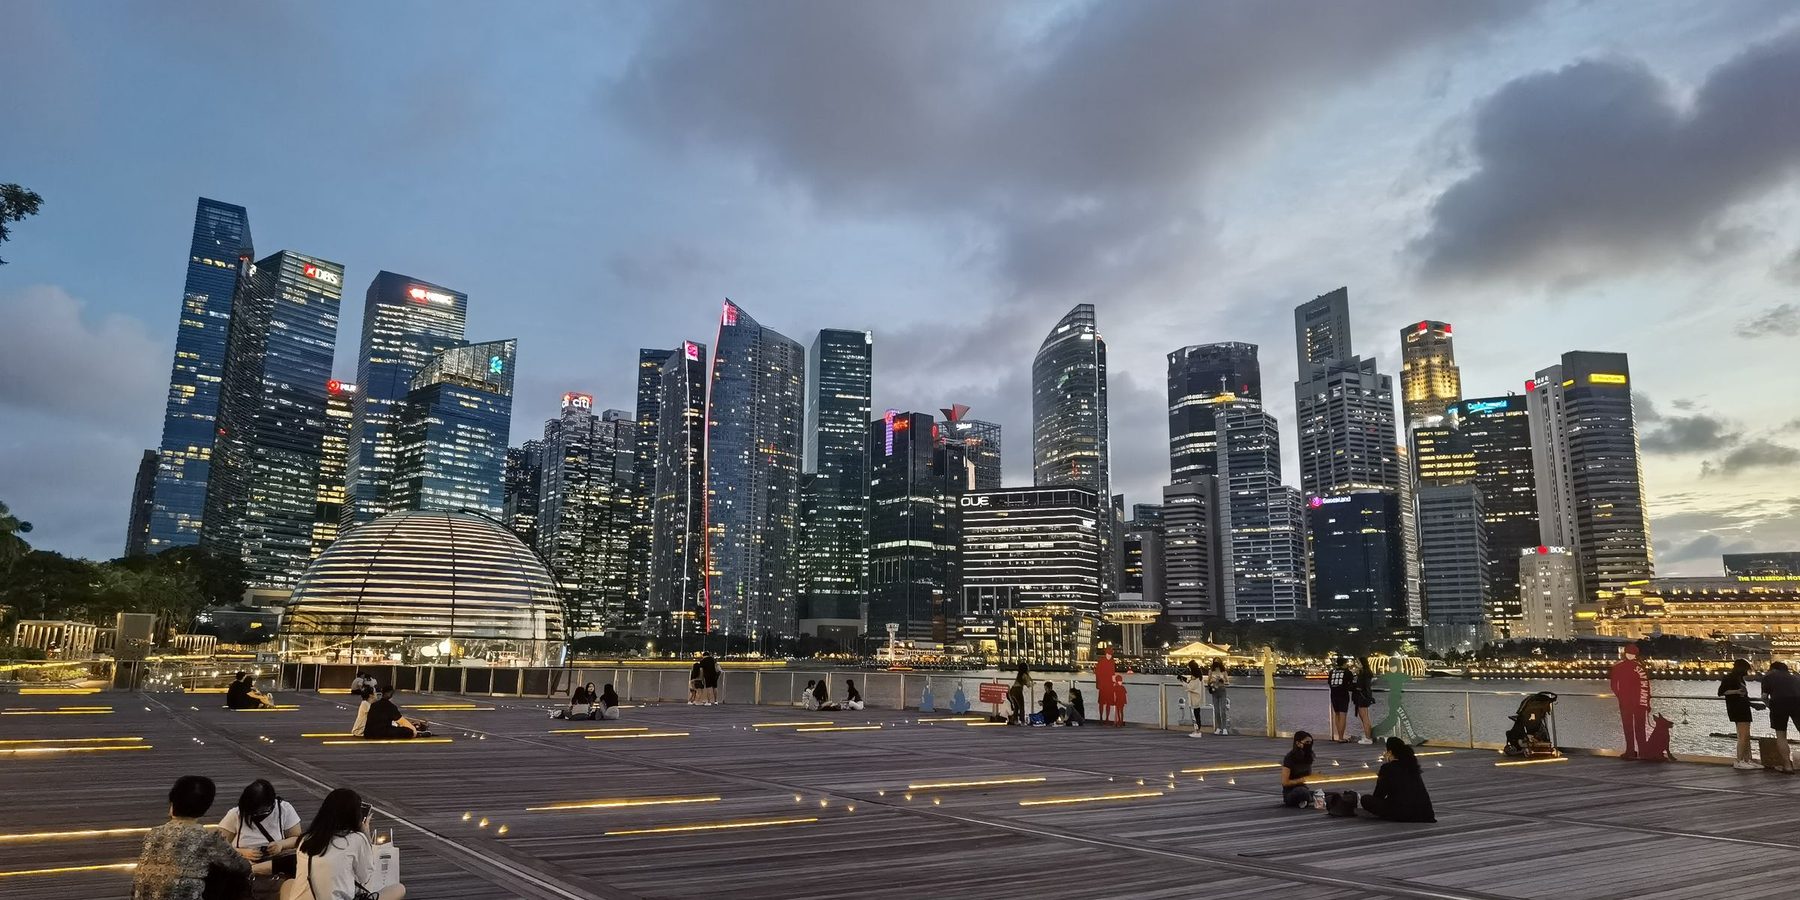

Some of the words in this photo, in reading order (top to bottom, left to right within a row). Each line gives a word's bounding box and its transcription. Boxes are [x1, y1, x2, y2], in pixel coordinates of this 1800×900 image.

[315, 268, 339, 285] DBS
[572, 398, 590, 409] citi
[960, 496, 990, 507] OUE
[1522, 548, 1535, 556] BOC
[1550, 546, 1566, 554] BOC
[1634, 665, 1648, 680] STAY
[1640, 688, 1649, 707] APART
[1397, 706, 1408, 720] STAY
